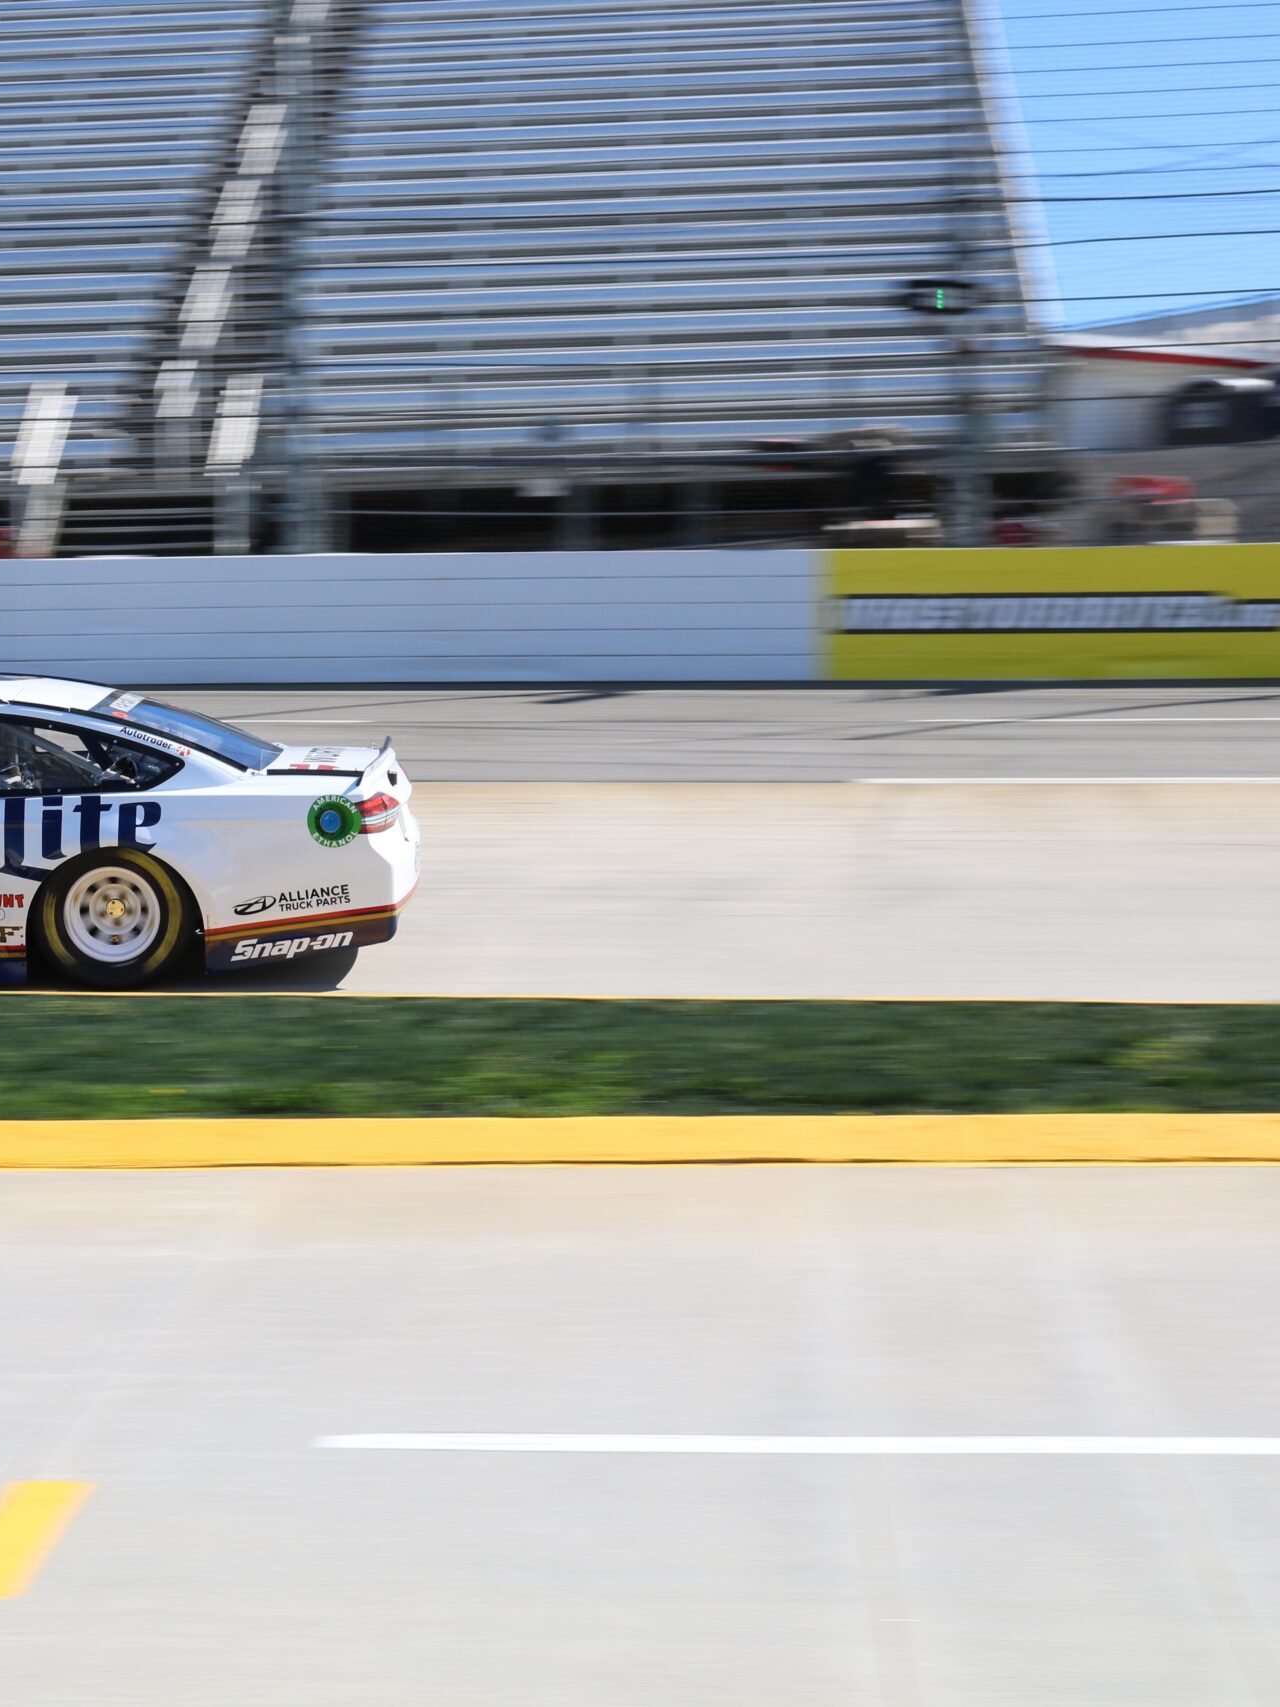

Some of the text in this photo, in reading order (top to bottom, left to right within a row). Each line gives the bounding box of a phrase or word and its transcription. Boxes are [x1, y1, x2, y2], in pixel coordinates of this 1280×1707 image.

[120, 727, 173, 750] Autotrader
[313, 795, 357, 814] AMERICAN
[313, 830, 357, 847] ETHANOL
[278, 884, 349, 904] ALLIANCE
[279, 895, 351, 912] TRUCK PARTS
[230, 931, 354, 962] Snap-on
